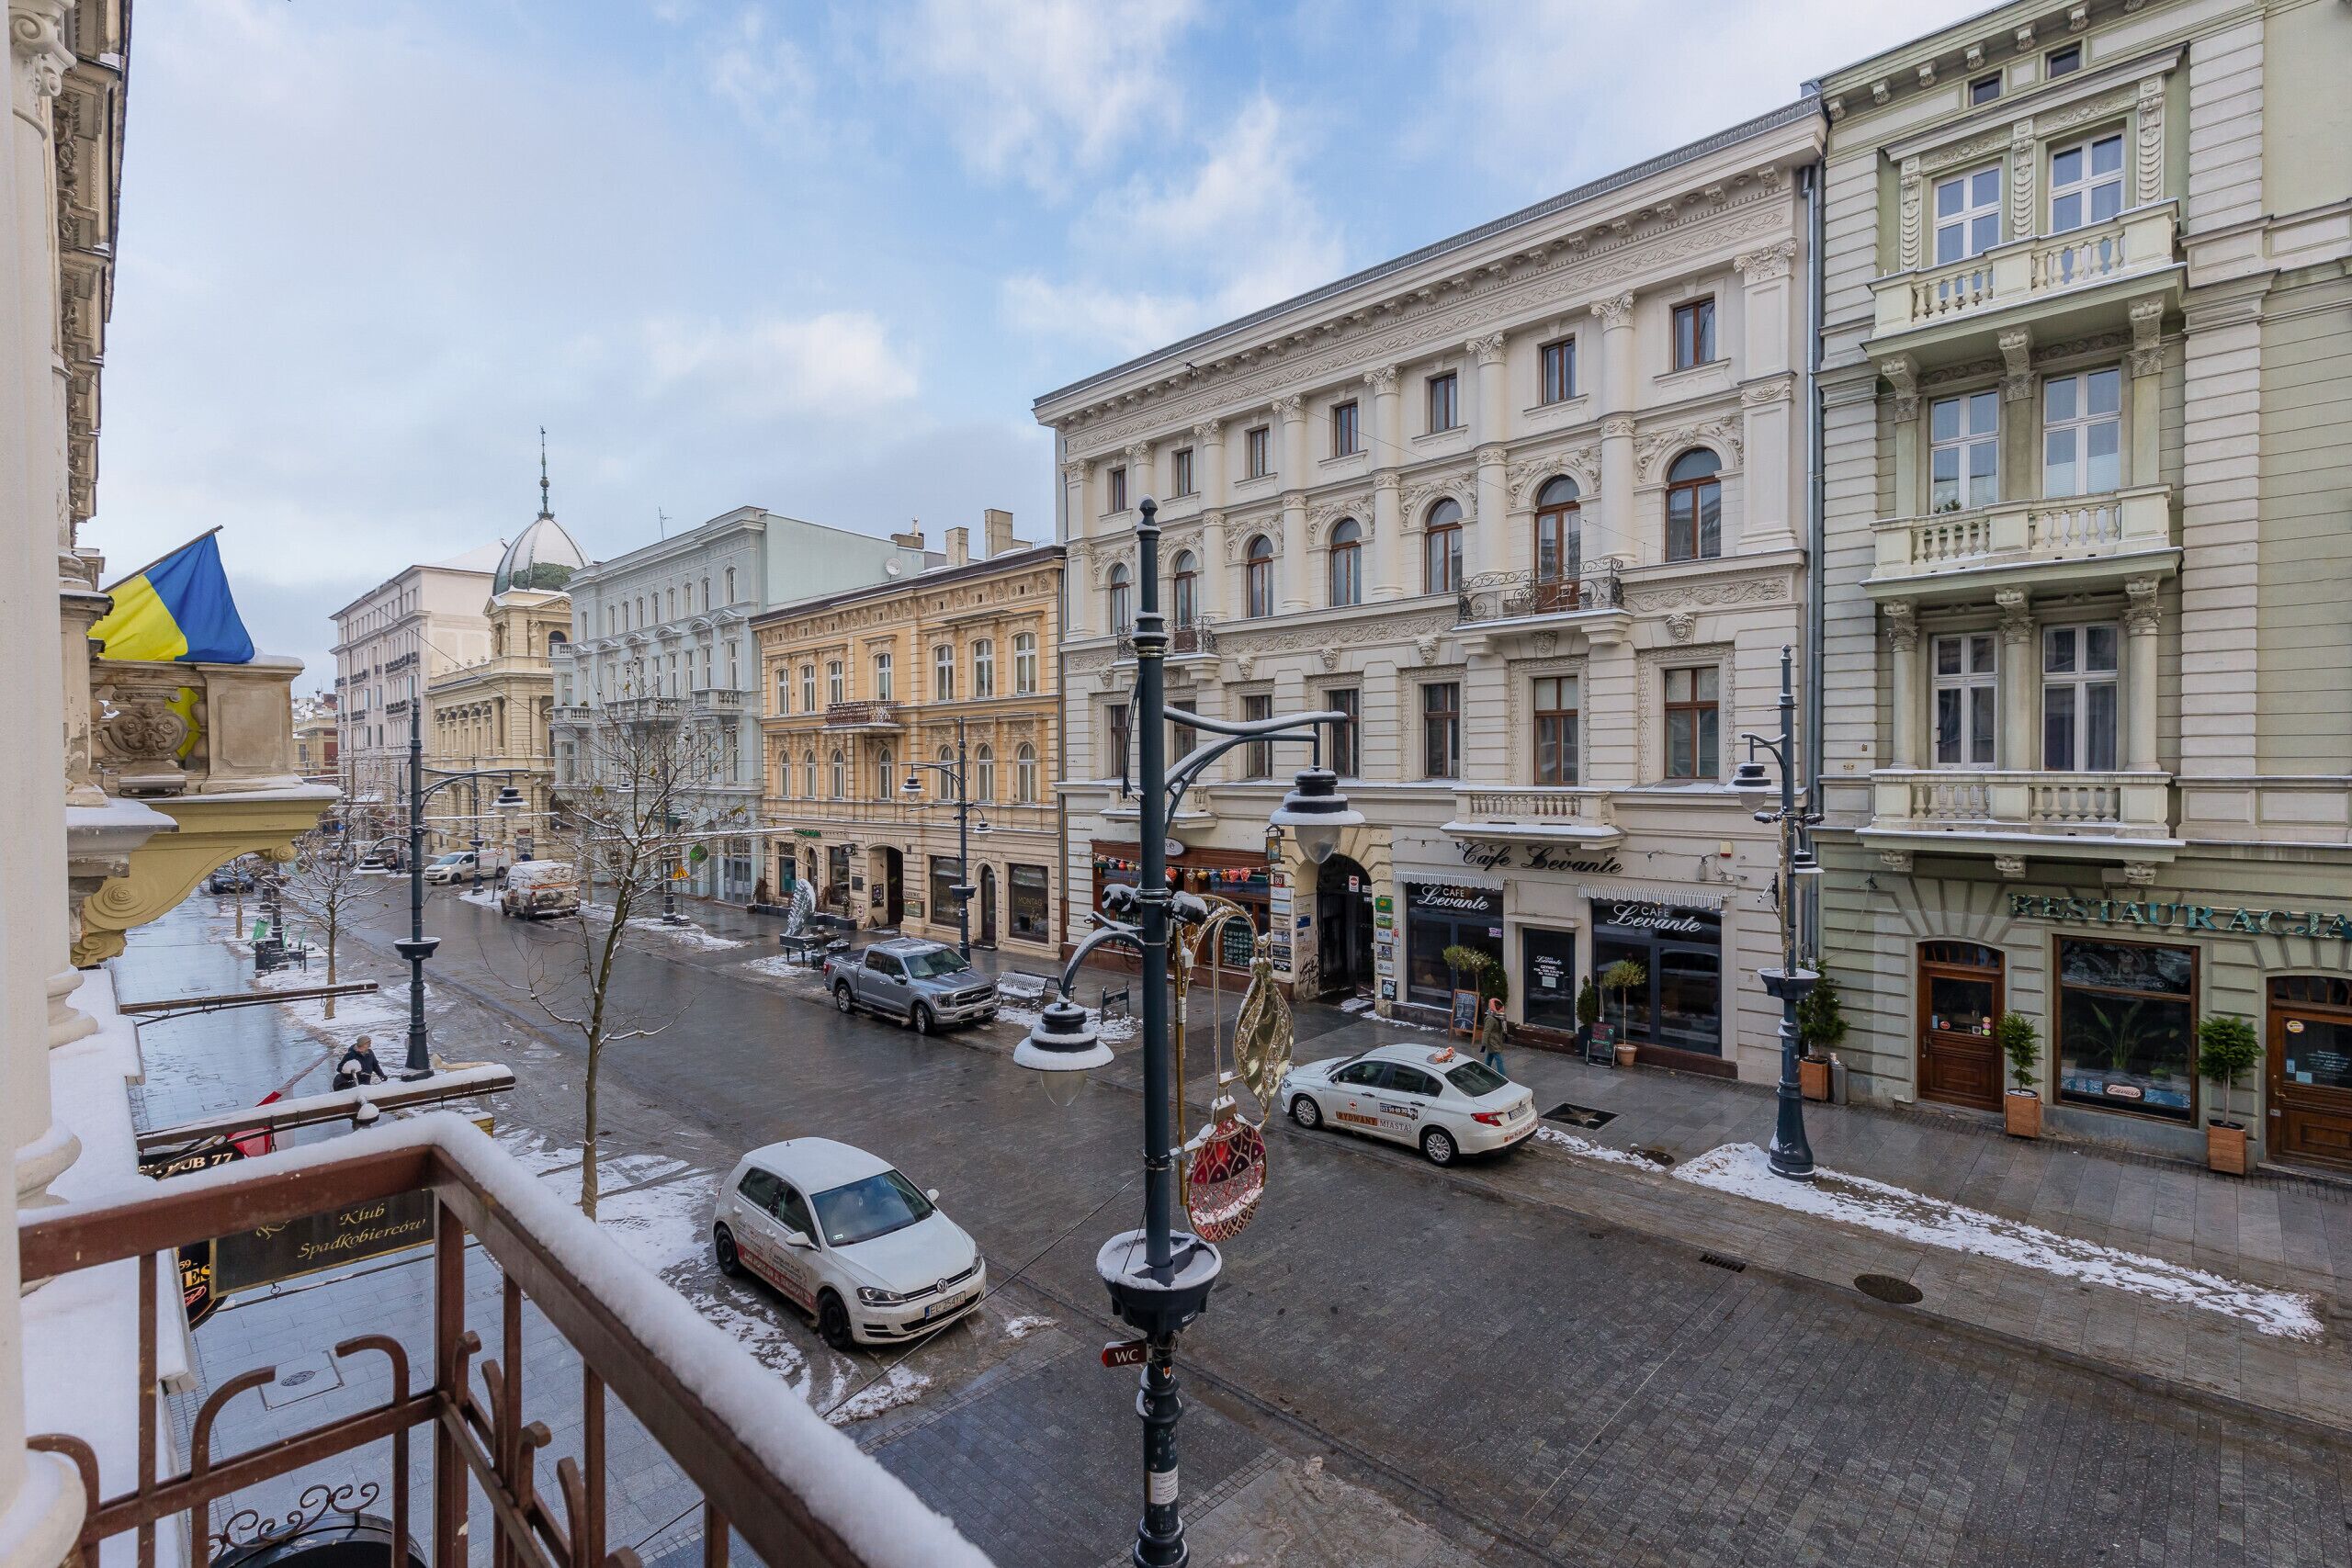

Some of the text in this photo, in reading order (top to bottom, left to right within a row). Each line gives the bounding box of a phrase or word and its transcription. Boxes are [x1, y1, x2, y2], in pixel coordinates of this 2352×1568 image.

[1462, 842, 1624, 874] Cafe Levante
[1275, 876, 1283, 885] 80
[1417, 886, 1489, 910] Levante
[1442, 887, 1464, 897] CAFE
[1607, 904, 1702, 932] Levante
[1641, 907, 1669, 918] CAFE
[2007, 892, 2352, 942] RESTAURACJA
[1339, 1111, 1408, 1132] RYDWANY MIASTA
[211, 1153, 233, 1165] 77
[339, 1202, 386, 1226] Klub
[297, 1218, 426, 1259] Spadkobierców
[1114, 1348, 1138, 1363] WC
